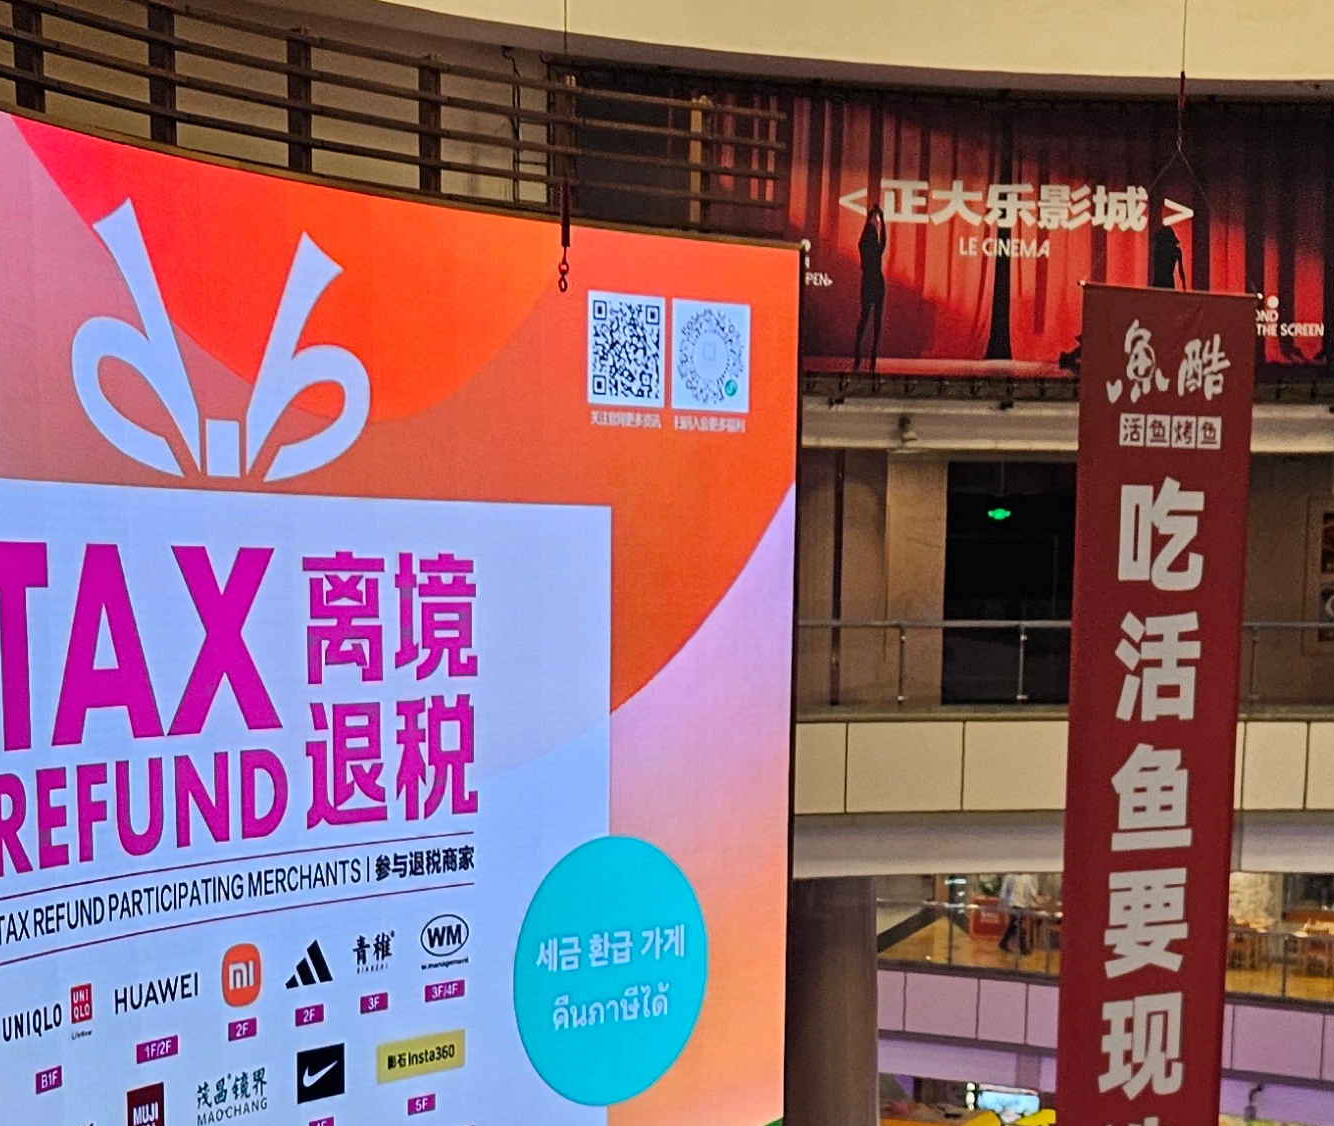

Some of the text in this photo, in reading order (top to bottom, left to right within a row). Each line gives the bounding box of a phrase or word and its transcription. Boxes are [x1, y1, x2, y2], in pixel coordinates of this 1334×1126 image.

[880, 179, 1148, 231] 正大乐影城
[960, 237, 1051, 258] LE CINEMA
[1280, 322, 1324, 337] SCREEN
[302, 551, 478, 684] 离境
[306, 694, 479, 830] 退税
[376, 846, 474, 882] 参与退税商家
[34, 897, 104, 938] REFUND
[109, 874, 244, 921] PARTICIPATING
[249, 858, 361, 898] MERCHANTS
[427, 924, 463, 948] WM
[535, 923, 685, 973] 세금 환급 가게
[73, 988, 89, 1004] UNI
[114, 972, 199, 1015] HUAWEI
[431, 982, 459, 998] 3F/4F
[73, 1004, 90, 1021] QLO
[368, 996, 381, 1010] 3F
[2, 1003, 62, 1042] UNIQLO
[302, 1008, 316, 1023] 2F
[235, 1021, 249, 1037] 2F
[144, 1038, 172, 1059] 1F/2F
[41, 1070, 58, 1089] B1F
[133, 1102, 159, 1126] MUJI
[415, 1097, 428, 1111] 5F
